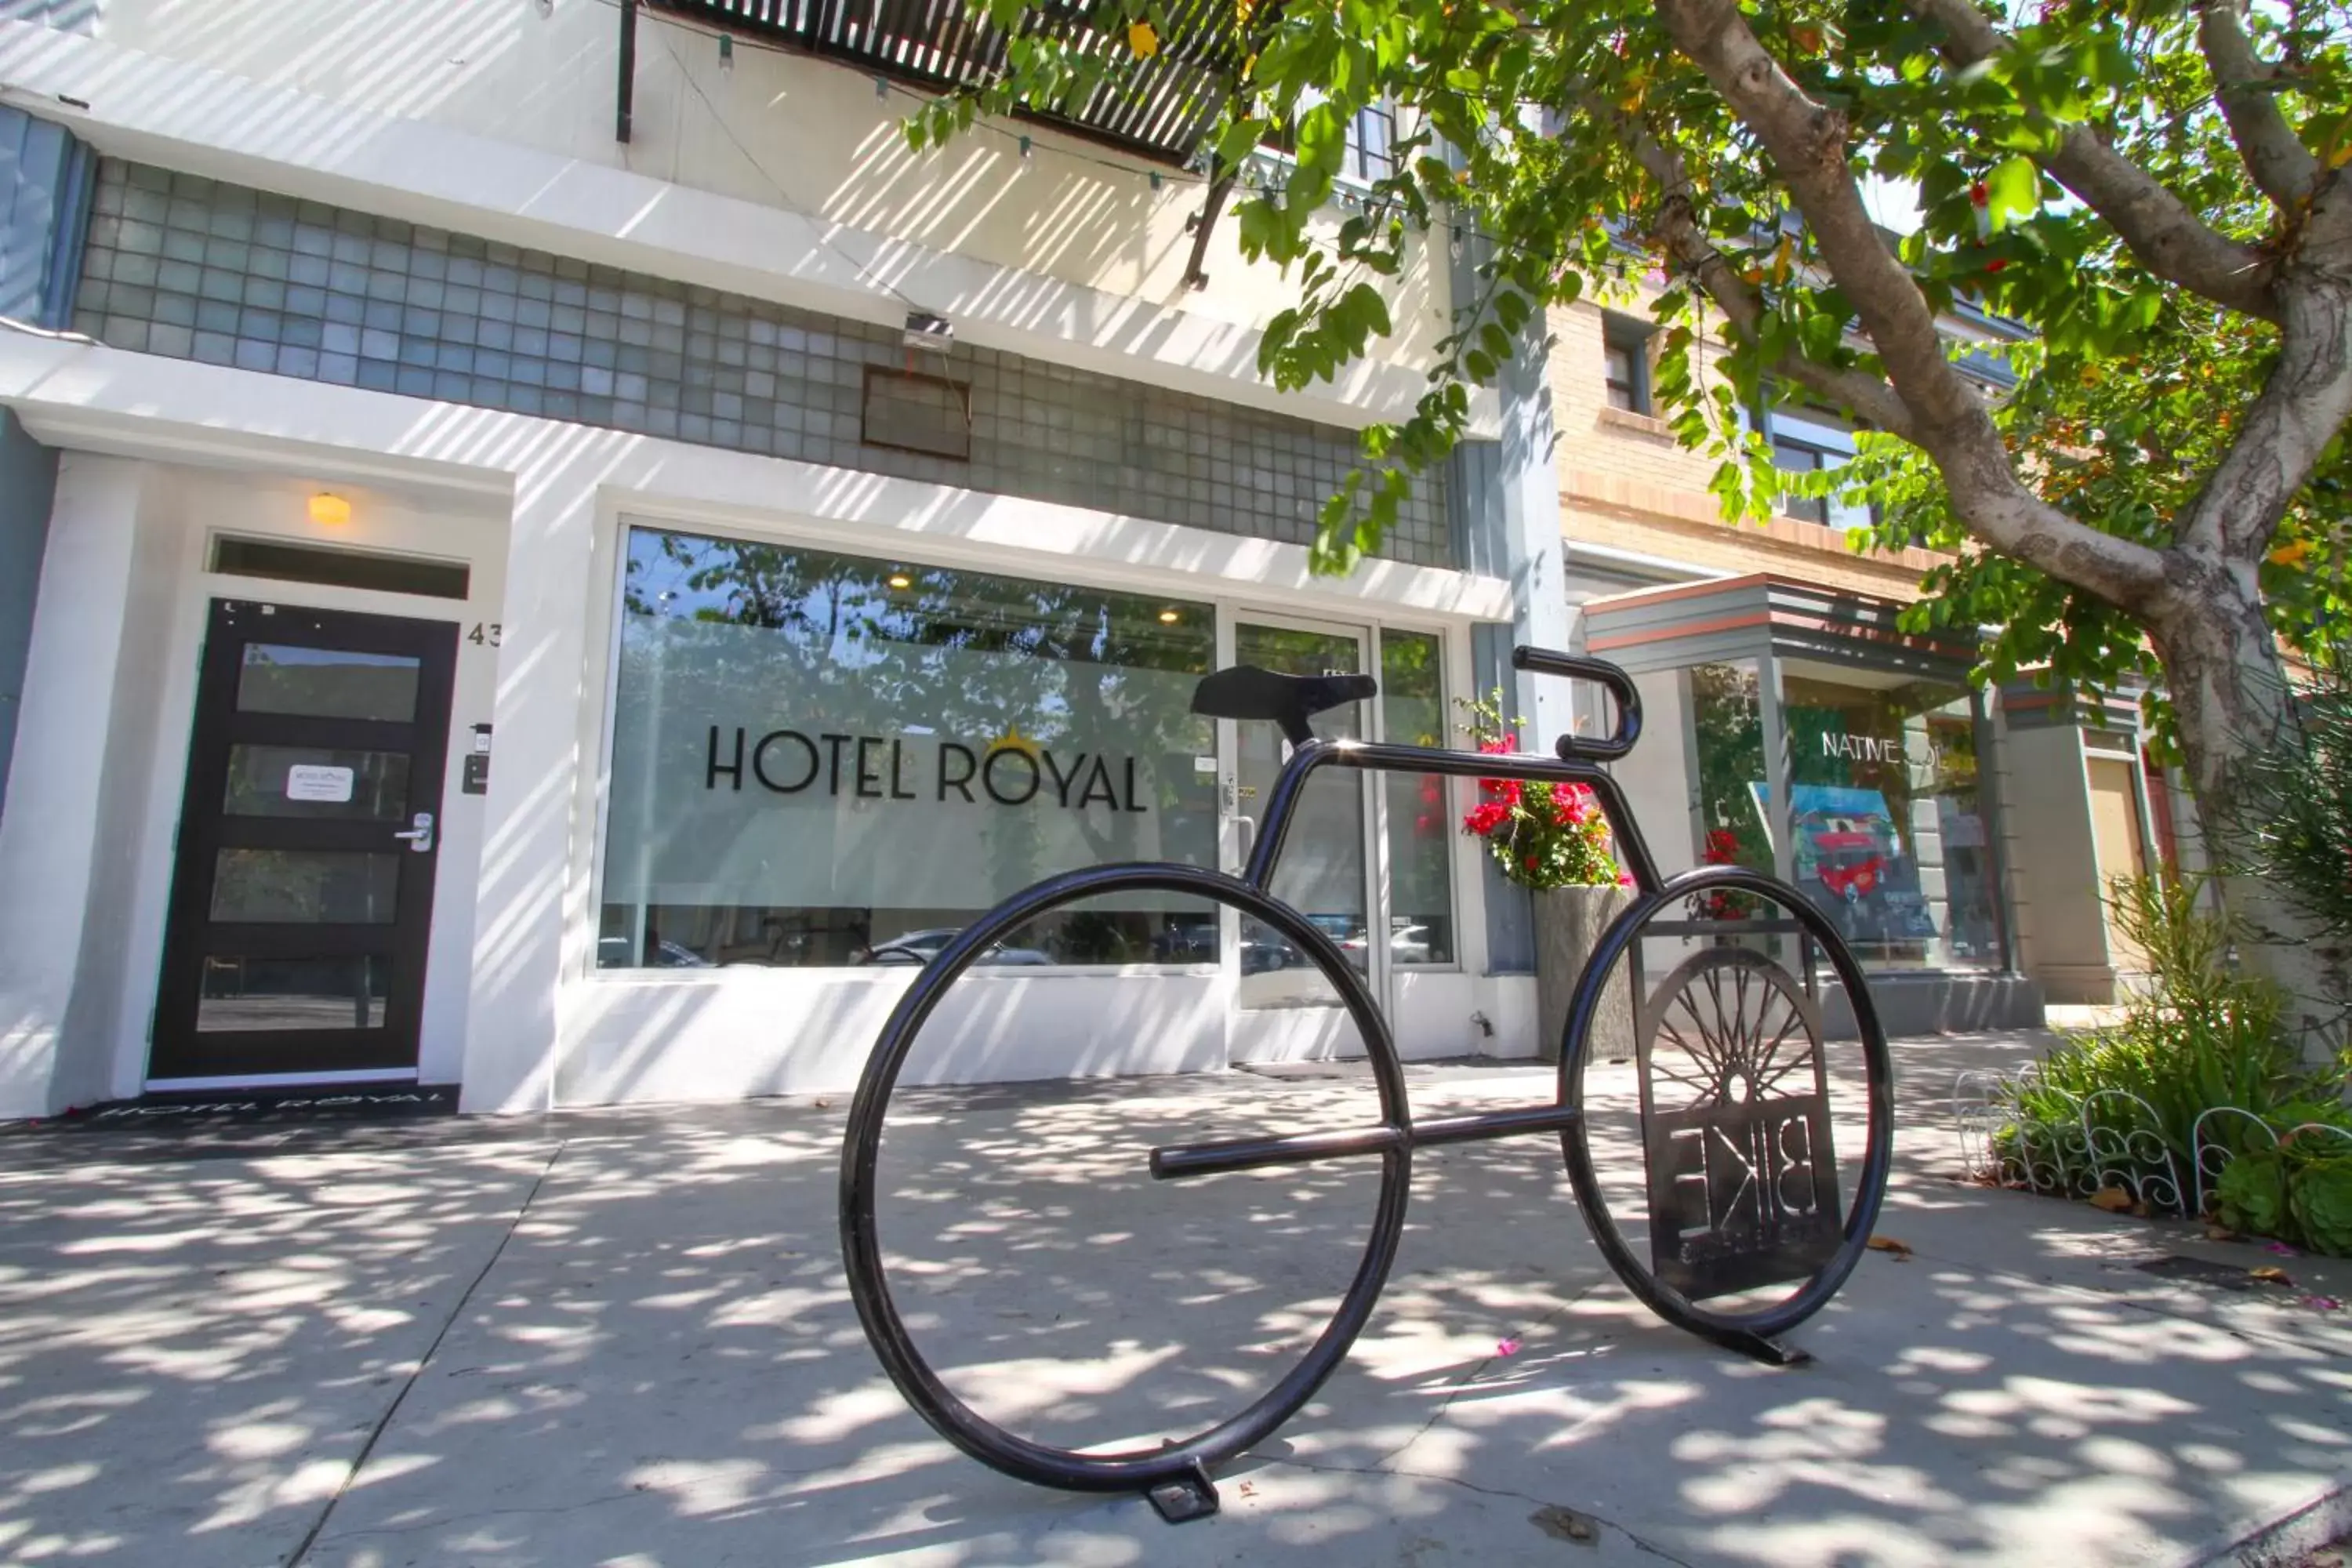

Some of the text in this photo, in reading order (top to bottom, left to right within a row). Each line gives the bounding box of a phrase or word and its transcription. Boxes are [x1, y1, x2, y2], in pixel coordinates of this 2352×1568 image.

[467, 622, 502, 648] 43
[1821, 730, 1900, 764] NATIVE
[706, 725, 916, 800] HOTEL
[937, 741, 1148, 813] ROYAL
[97, 1093, 445, 1118] HOTEL ROYAL
